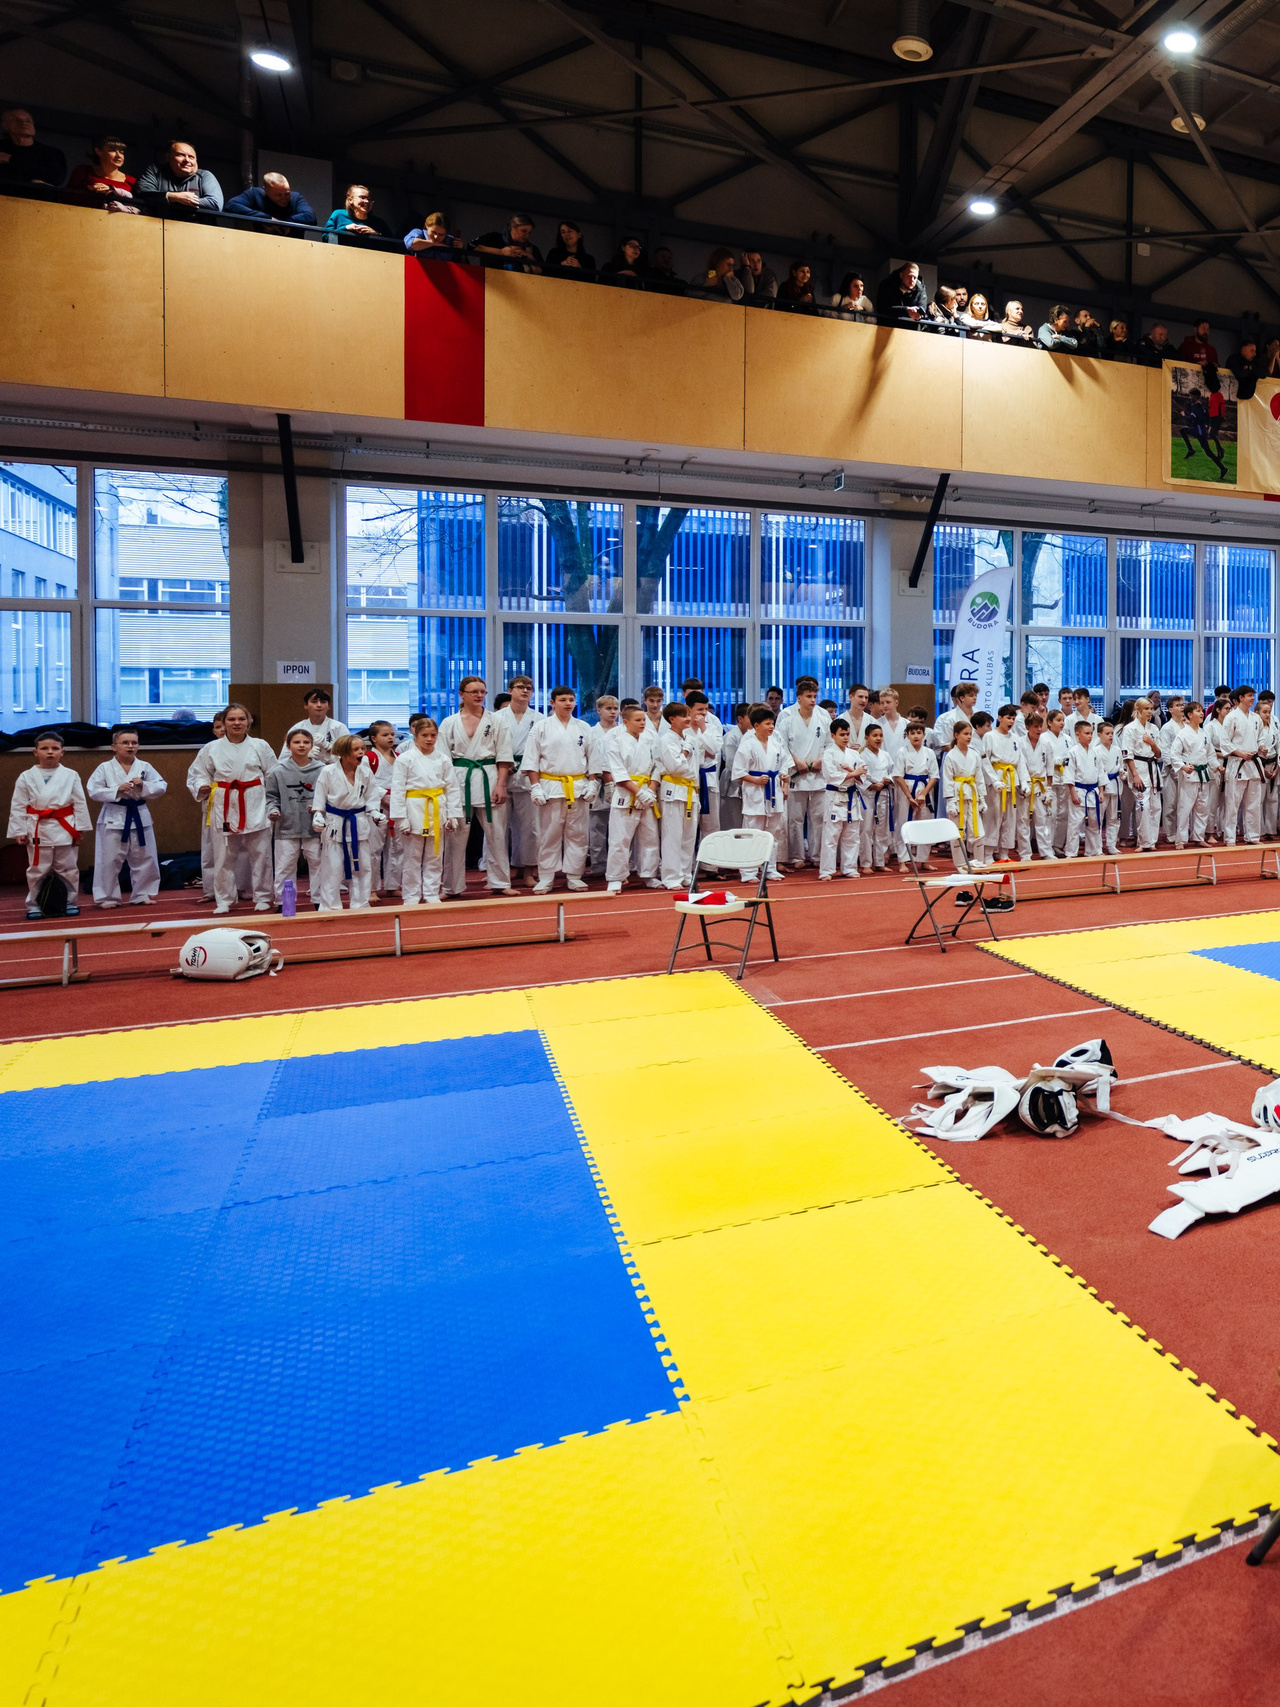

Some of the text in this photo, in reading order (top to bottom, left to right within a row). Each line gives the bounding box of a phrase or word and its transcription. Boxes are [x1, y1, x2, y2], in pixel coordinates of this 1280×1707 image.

[967, 617, 999, 630] BUDORA
[283, 664, 310, 675] IPPON
[960, 648, 980, 681] RA
[986, 650, 995, 687] KLUBAS
[908, 667, 931, 677] BUDORA
